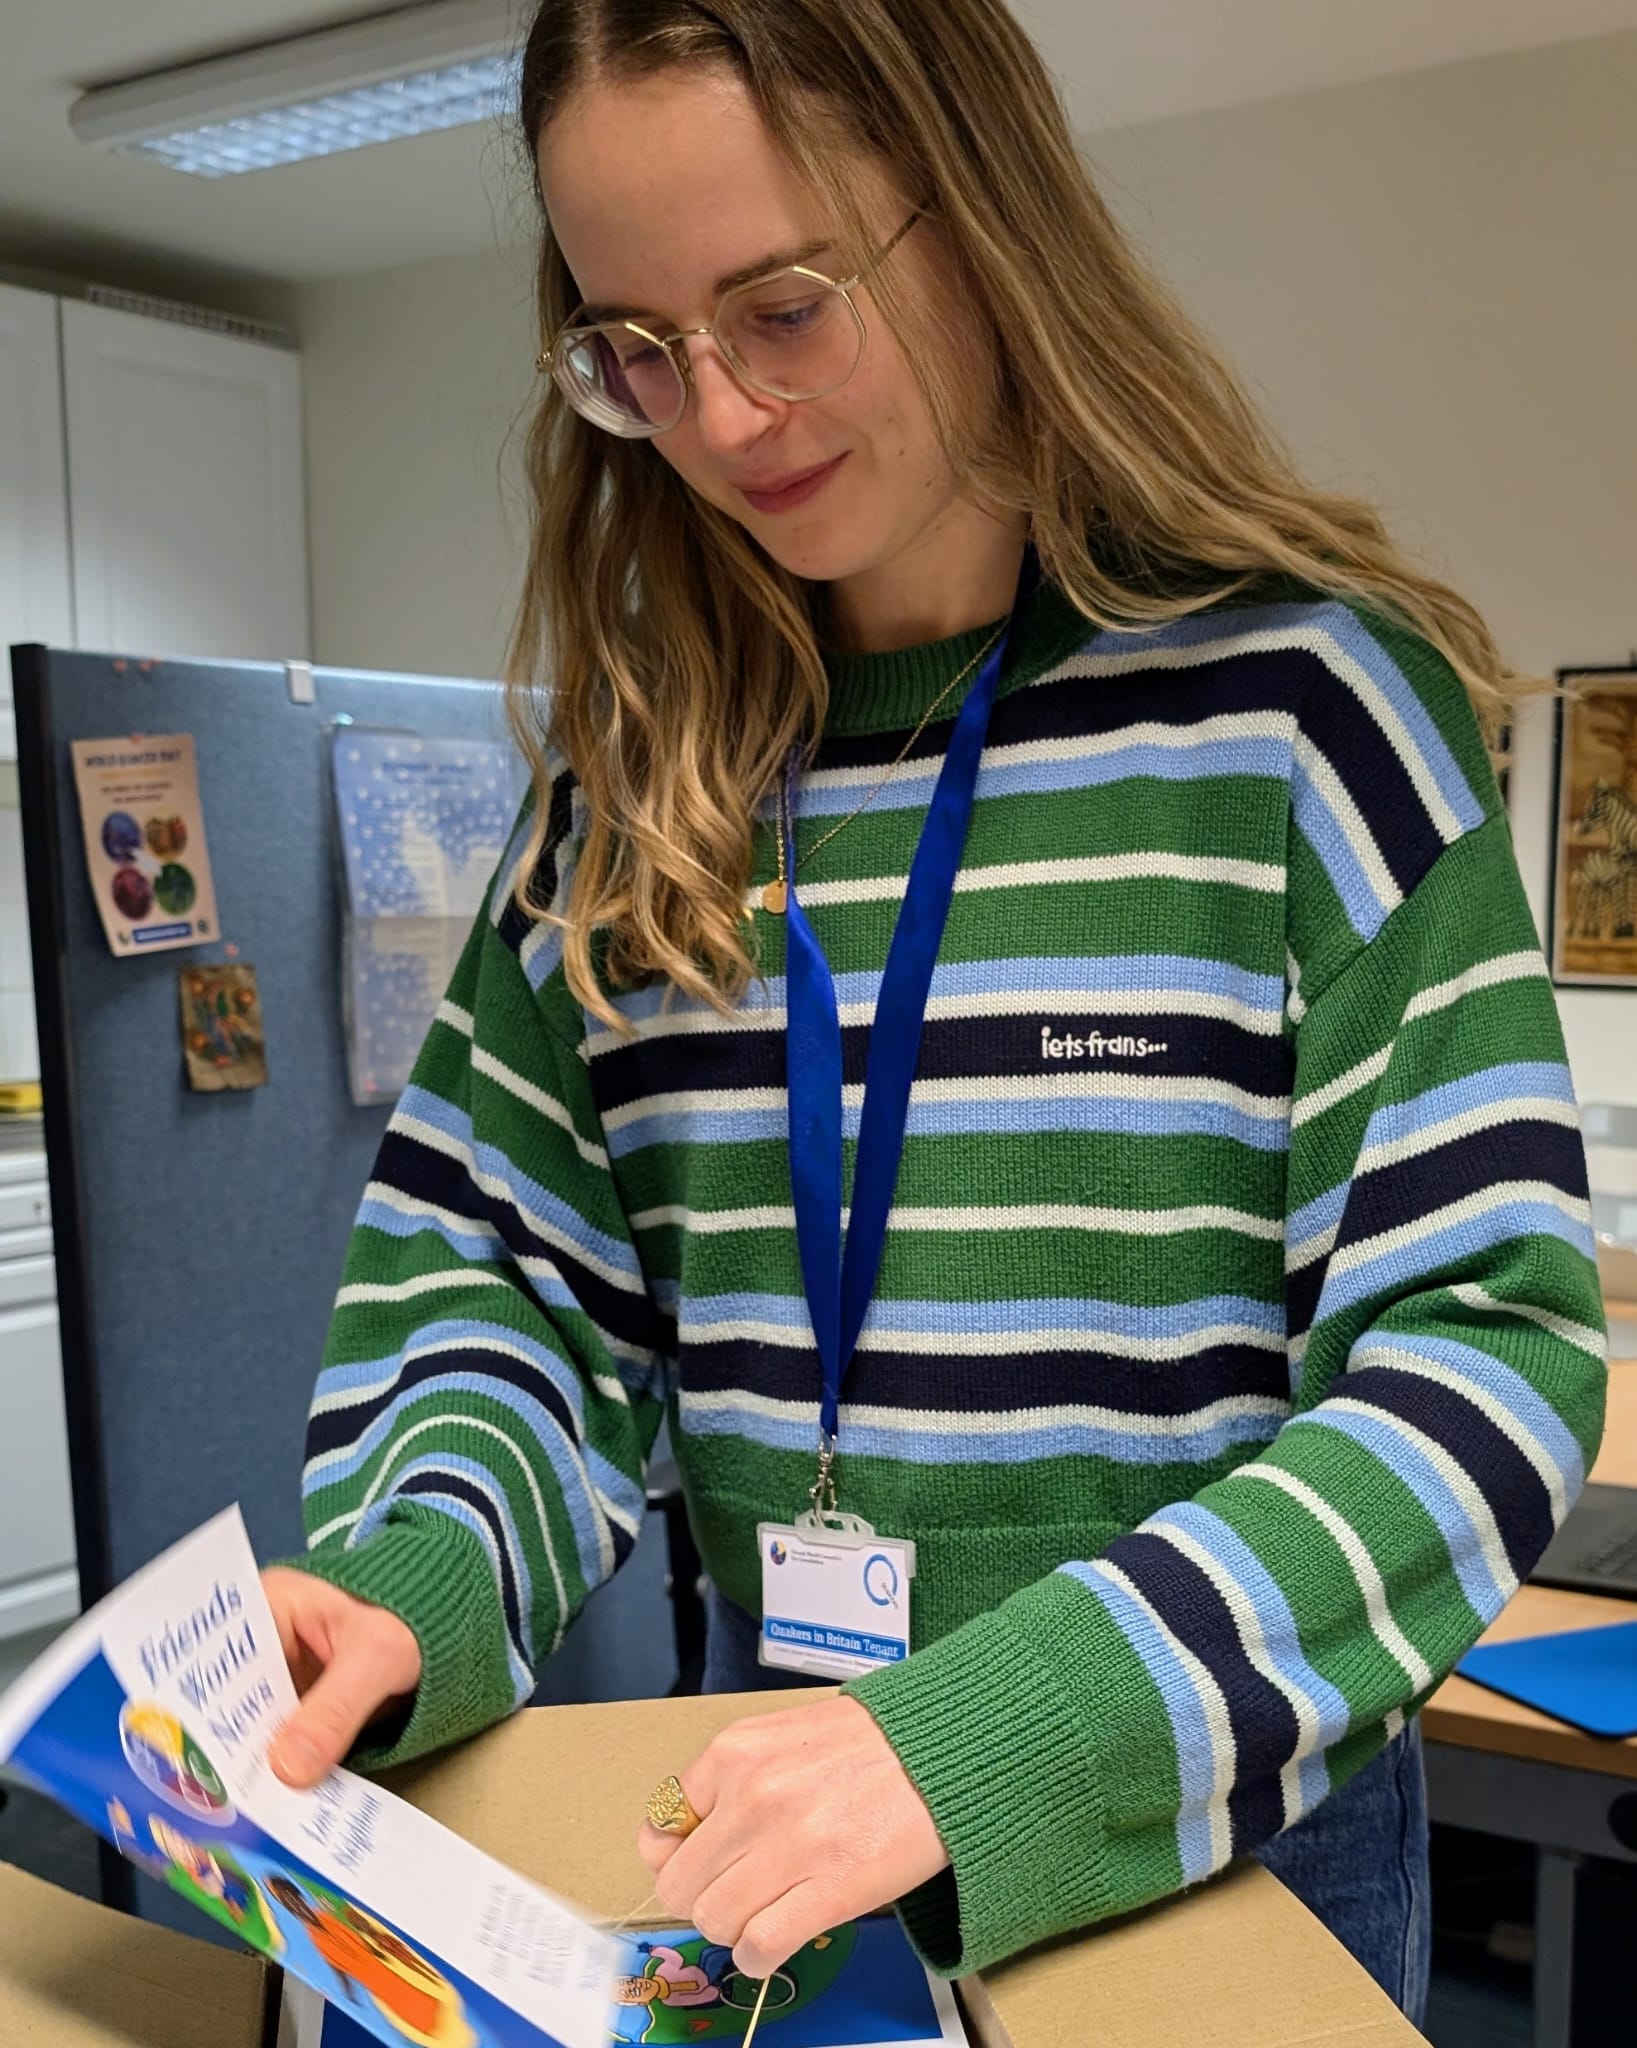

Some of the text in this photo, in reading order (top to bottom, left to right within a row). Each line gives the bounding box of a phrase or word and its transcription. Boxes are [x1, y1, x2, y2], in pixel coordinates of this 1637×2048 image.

[139, 1579, 242, 1692] Friends
[178, 1617, 257, 1714] World
[770, 1622, 812, 1642] Quakers
[813, 1628, 824, 1644] in
[826, 1631, 861, 1651] Britain
[863, 1638, 899, 1658] Tenant
[207, 1675, 274, 1758] News
